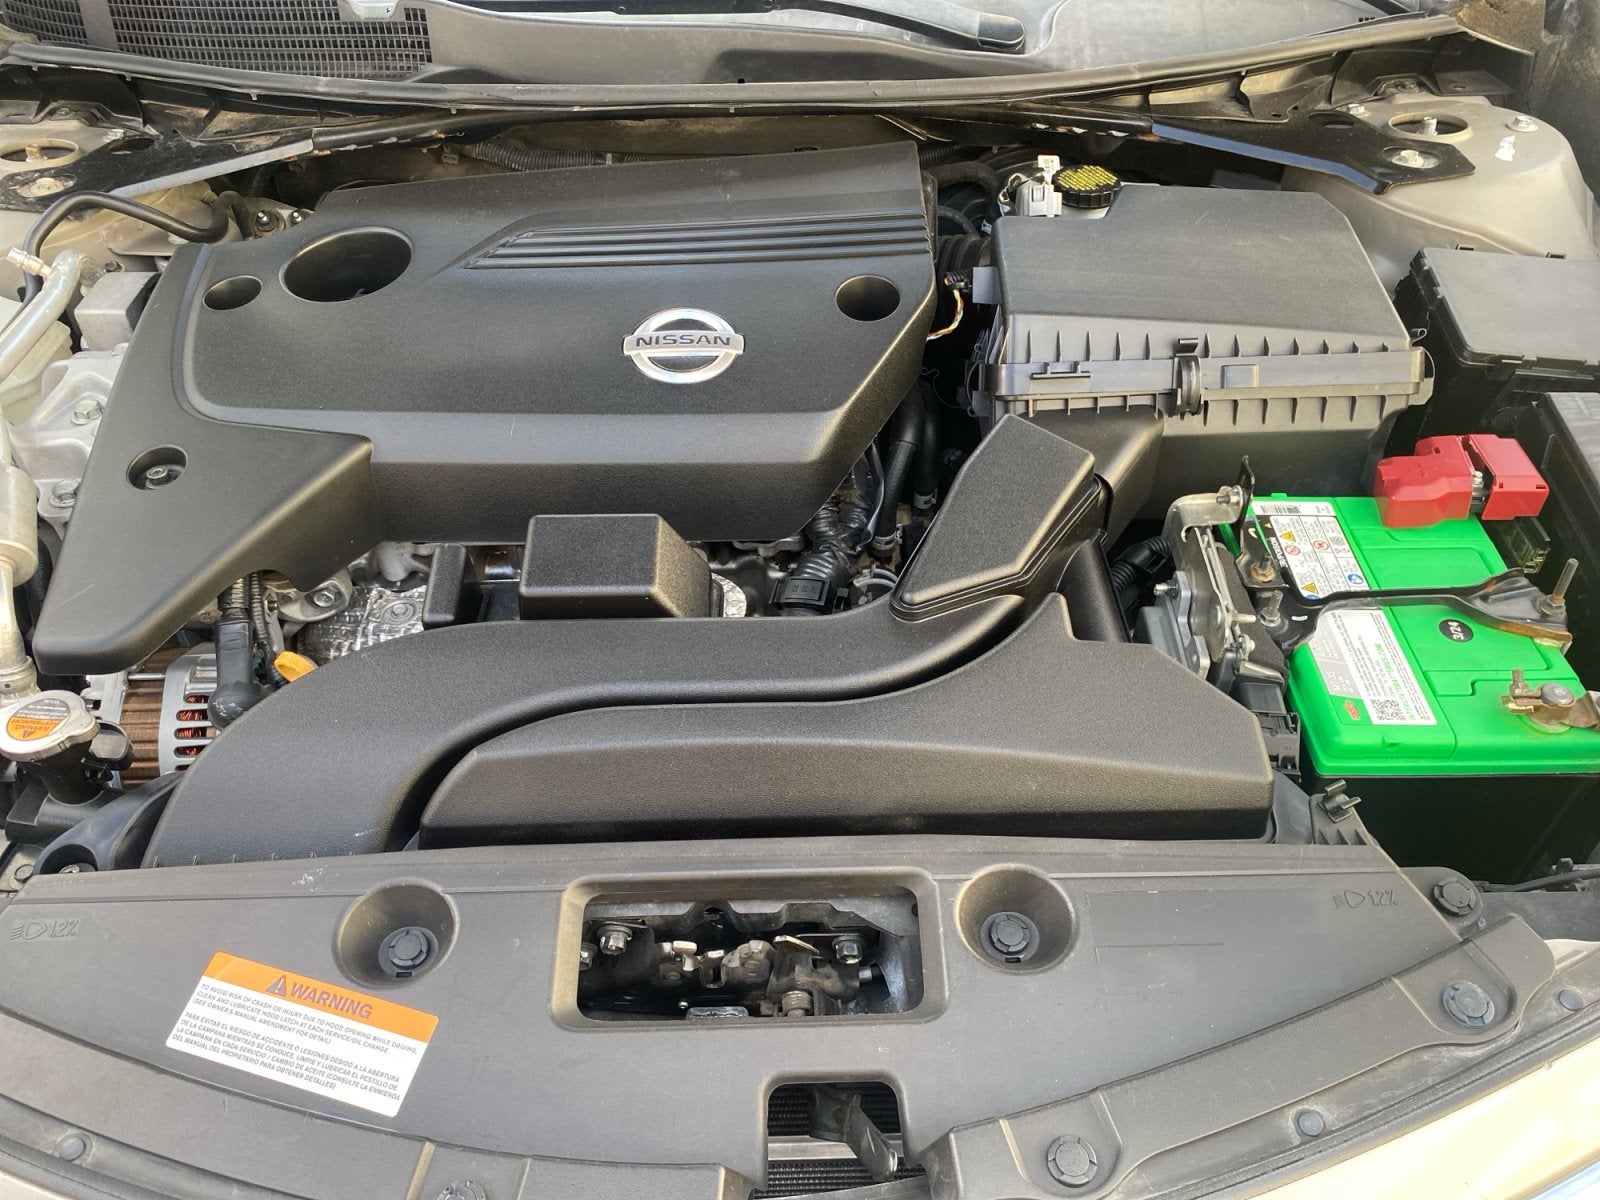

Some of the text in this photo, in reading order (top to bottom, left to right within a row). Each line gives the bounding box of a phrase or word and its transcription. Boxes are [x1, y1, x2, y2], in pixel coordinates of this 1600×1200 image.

[635, 334, 731, 347] NISSAN
[1448, 620, 1465, 640] 3/24
[196, 990, 216, 1001] CLEAN
[216, 996, 230, 1005] AND
[230, 1000, 261, 1014] LUBRICATE
[261, 1010, 280, 1020] HOOD
[280, 1015, 299, 1026] LATCH
[307, 1024, 324, 1034] EACH
[363, 1040, 389, 1053] CHANGE
[209, 986, 228, 996] AVOID
[228, 991, 242, 1000] RISK
[251, 998, 272, 1009] CRASH
[282, 1008, 302, 1019] INJURY
[303, 1014, 316, 1023] DUE
[325, 1021, 344, 1031] HOOD
[344, 1026, 371, 1040] OPENING
[372, 1035, 391, 1046] WHILE
[234, 1010, 258, 1022] MANUAL
[258, 1017, 295, 1033] AMENDMENT
[295, 1028, 308, 1037] FOR
[289, 981, 373, 1019] WARNING
[172, 1033, 184, 1042] DEL
[184, 1037, 208, 1050] MANUAL
[208, 1045, 220, 1053] DEL
[220, 1048, 259, 1065] PROPIETARIO
[259, 1060, 275, 1070] PARA
[275, 1066, 304, 1080] OBTENER
[184, 1011, 200, 1021] PARA
[200, 1016, 221, 1027] EVITAR
[229, 1025, 251, 1037] RIESGO
[261, 1035, 294, 1050] ACCIDENTE
[300, 1047, 329, 1061] LESIONES
[330, 1056, 353, 1068] DEBIDO
[368, 1067, 400, 1082] ABERTURA
[184, 1028, 213, 1042] CAMPANA
[222, 1040, 239, 1050] CADA
[239, 1045, 266, 1059] SERVICIO
[271, 1055, 295, 1068] CAMBIO
[304, 1065, 325, 1077] ACEITE
[369, 1085, 400, 1100] ENMIENDA
[197, 1024, 226, 1037] CAMPANA
[226, 1032, 256, 1047] MIENTRAS
[296, 1054, 316, 1065] LIMPIE
[360, 1074, 388, 1088] PESTILLO
